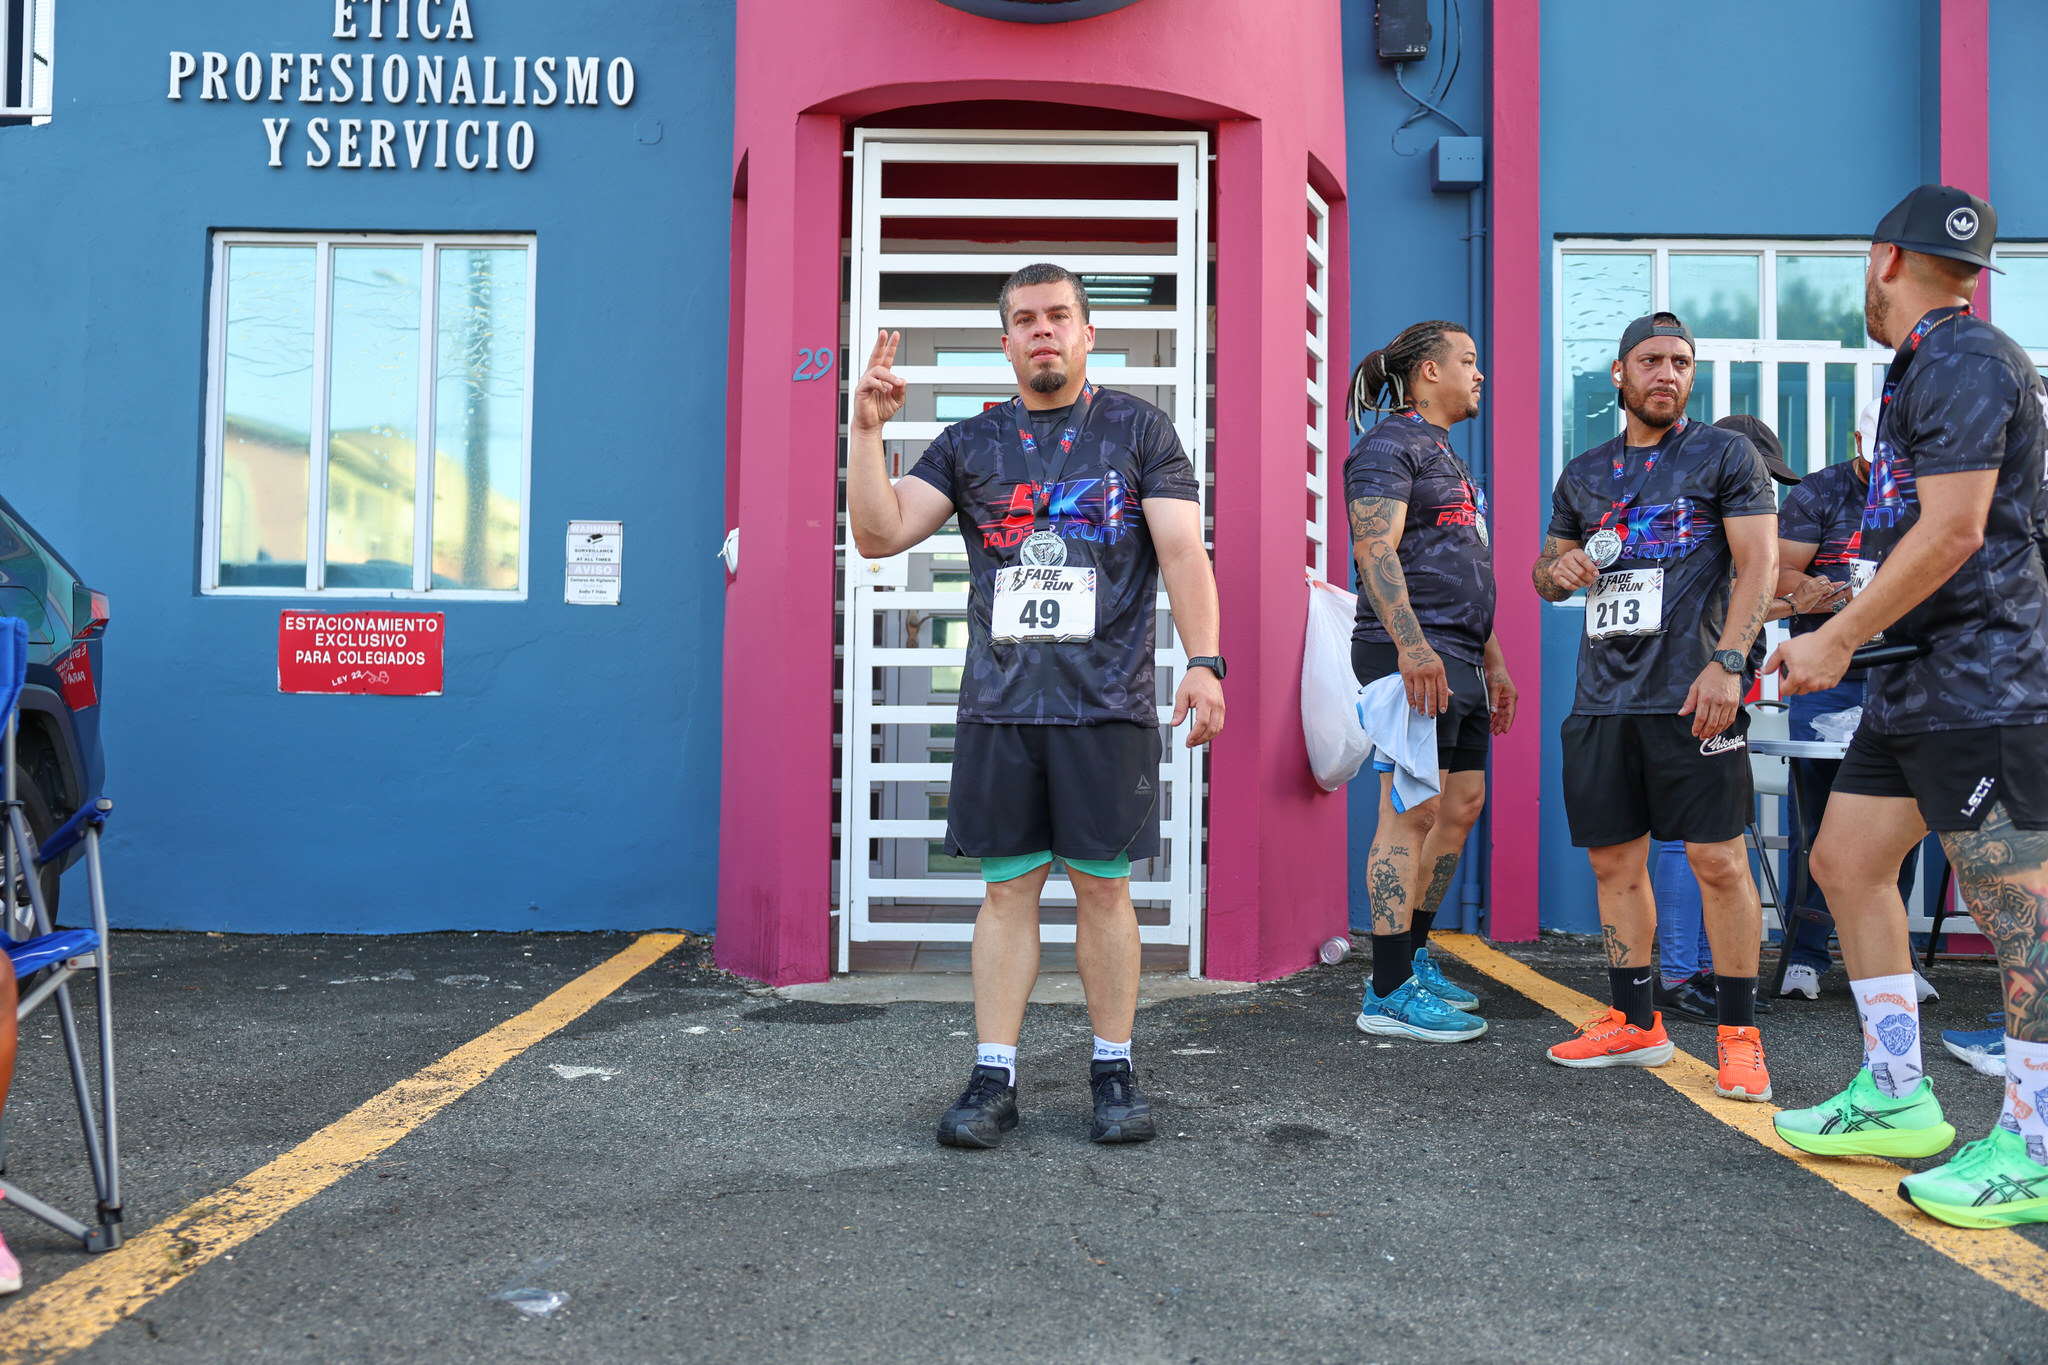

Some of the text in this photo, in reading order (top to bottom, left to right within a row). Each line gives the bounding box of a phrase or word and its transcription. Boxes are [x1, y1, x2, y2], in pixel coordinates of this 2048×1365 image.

[167, 51, 635, 106] PROFESIONALISMO
[262, 117, 535, 170] Y SERVICIO
[793, 347, 834, 381] 29
[1436, 511, 1476, 527] FADE
[1061, 522, 1118, 545] RUN
[1637, 542, 1686, 559] RUN
[574, 565, 613, 575] AVISO
[1024, 568, 1062, 581] FADE
[1606, 572, 1635, 584] FADE
[1033, 581, 1074, 592] & RUN
[1611, 582, 1644, 593] & RUN
[1019, 599, 1061, 629] 49
[1596, 599, 1640, 630] 213
[285, 616, 438, 632] ESTACIONAMIENTO
[315, 633, 407, 648] EXCLUSIVO
[295, 650, 426, 666] PARA COLEGIADOS
[331, 670, 363, 687] LEY 22
